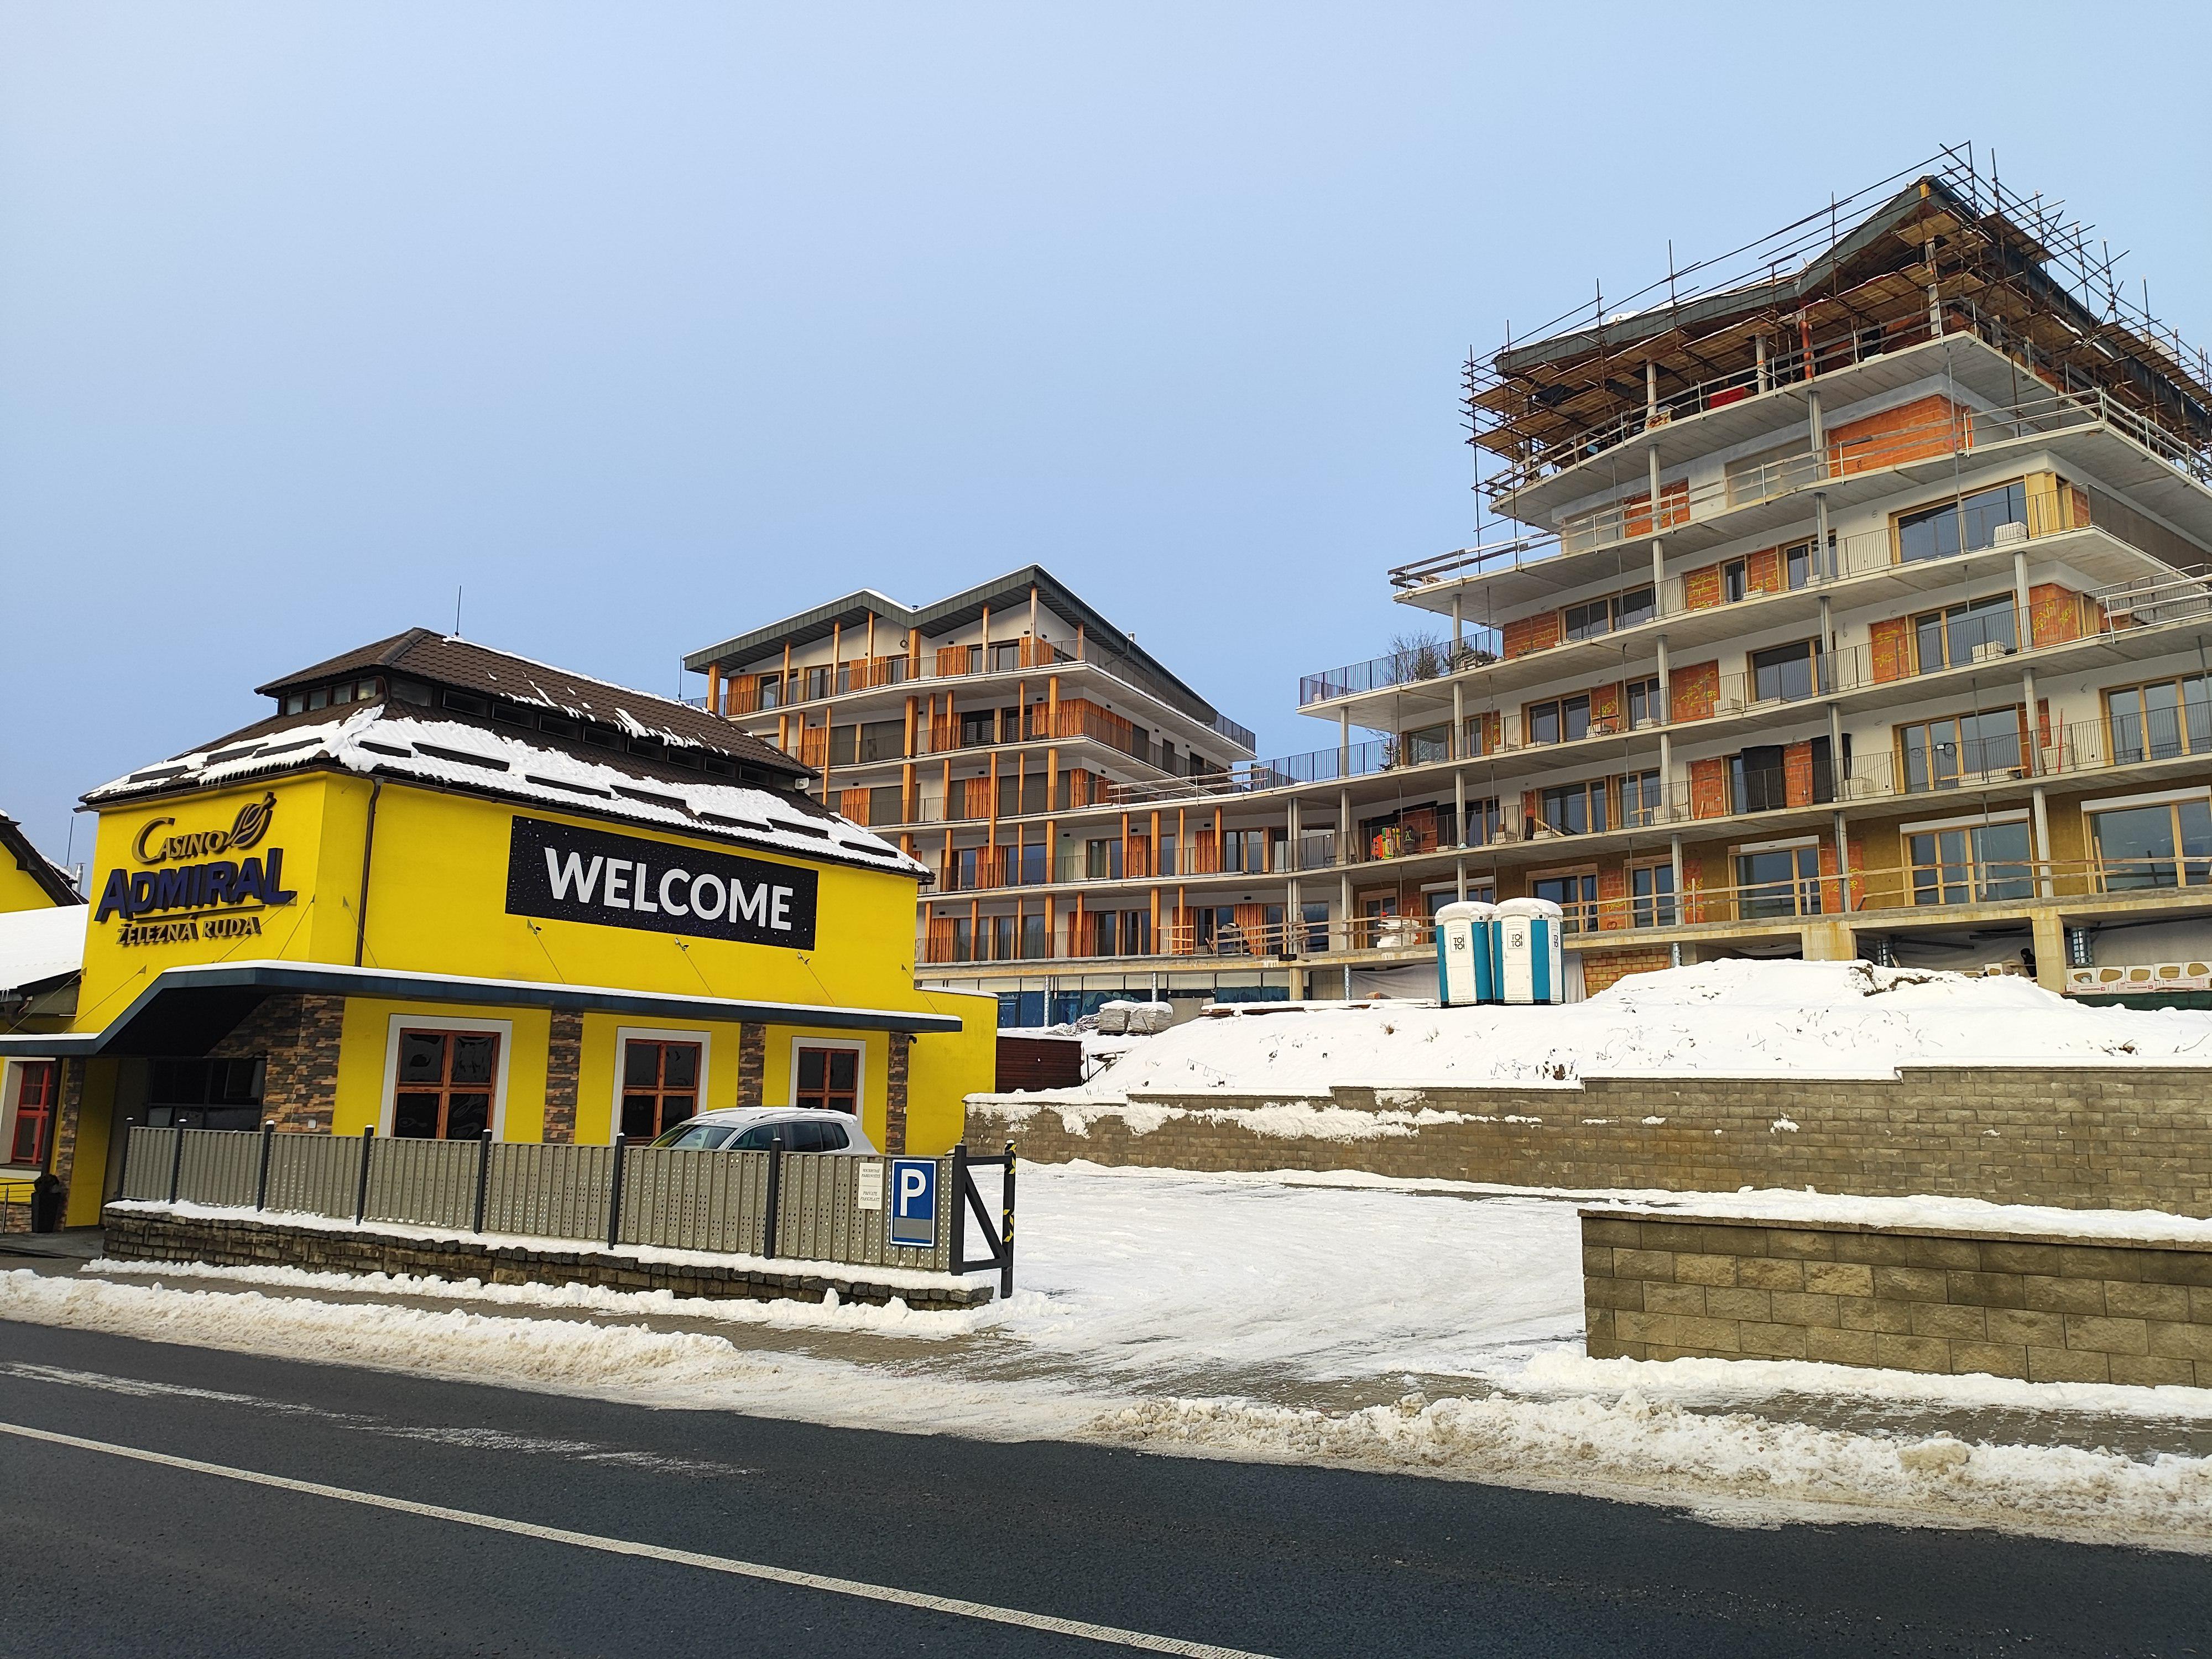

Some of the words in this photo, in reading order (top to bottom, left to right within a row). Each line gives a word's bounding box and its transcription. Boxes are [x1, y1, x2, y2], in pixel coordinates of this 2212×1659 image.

[132, 817, 229, 863] CASINO
[93, 848, 297, 922] ADMIRAL
[544, 847, 794, 931] WELCOME
[202, 916, 262, 938] RUDA
[900, 1169, 926, 1216] P
